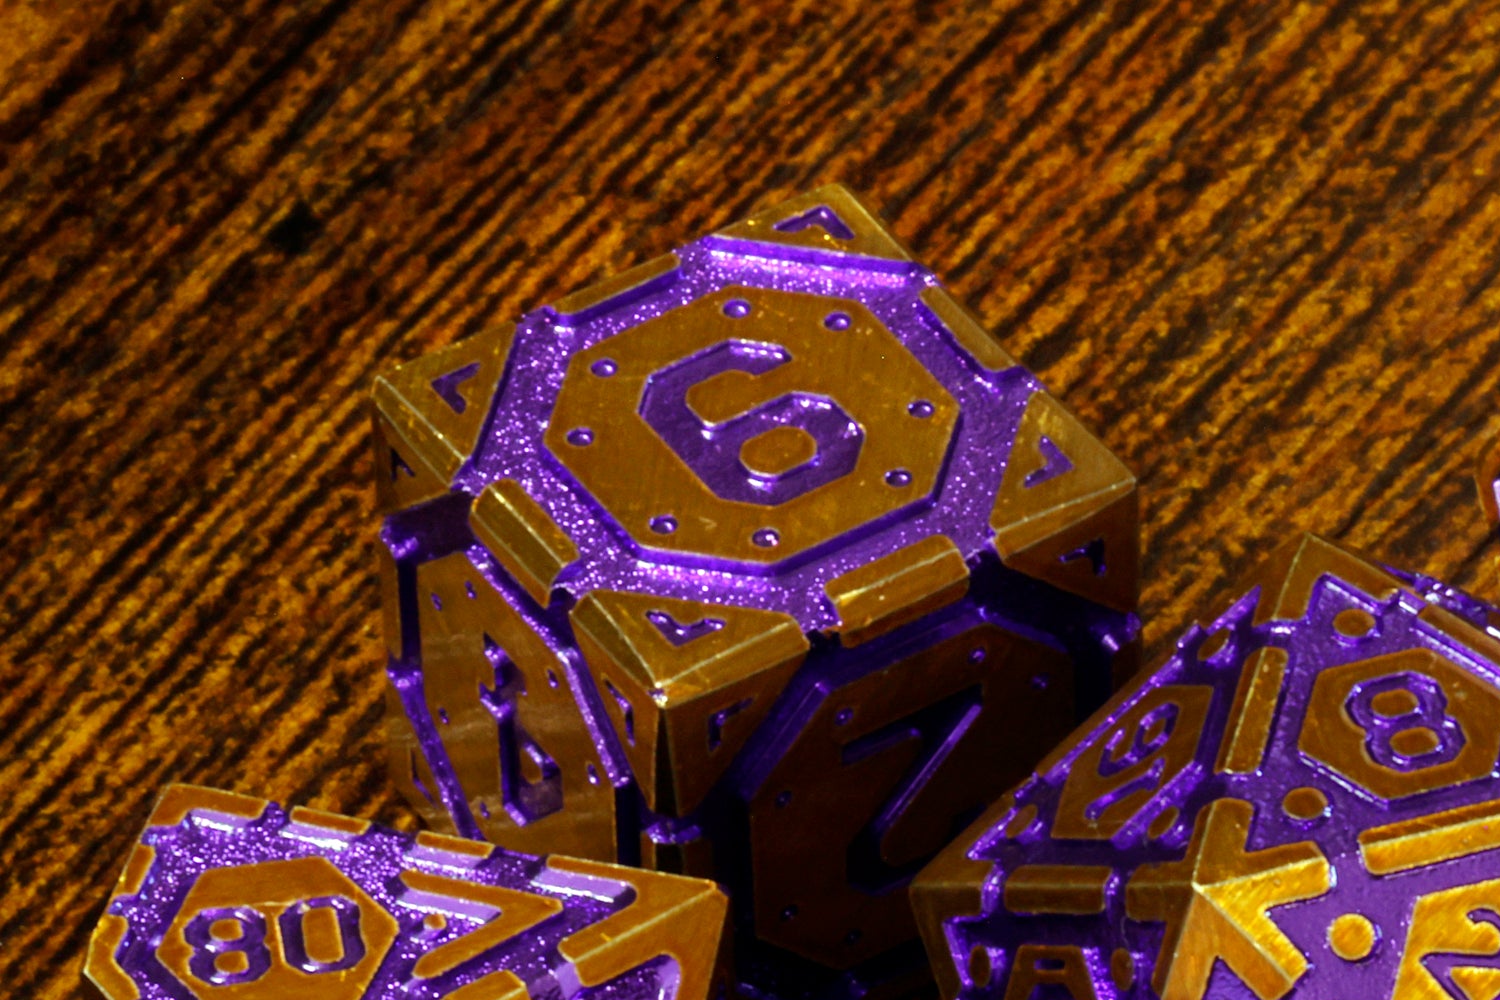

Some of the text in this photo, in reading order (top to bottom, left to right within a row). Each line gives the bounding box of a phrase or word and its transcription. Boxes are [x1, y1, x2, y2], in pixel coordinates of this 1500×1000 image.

[635, 336, 867, 507] 6
[1083, 701, 1182, 822] 16
[1344, 669, 1467, 773] 8
[182, 894, 369, 988] 80
